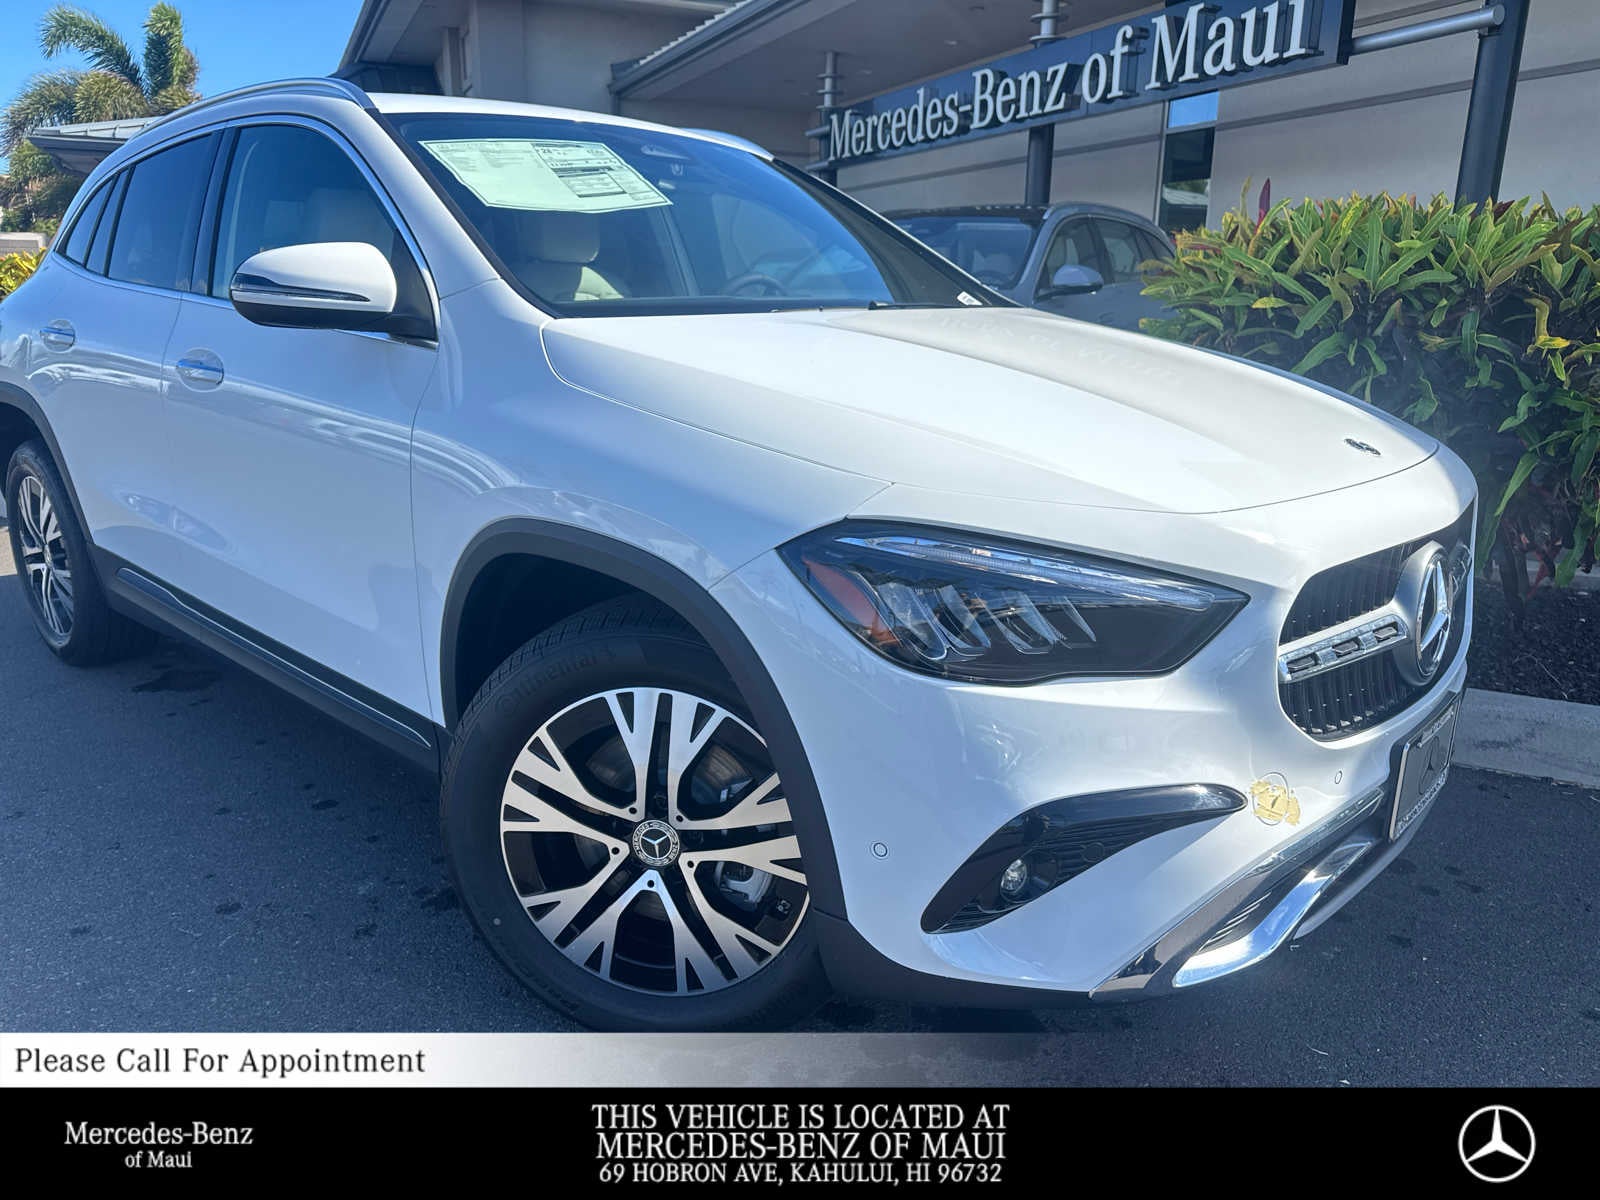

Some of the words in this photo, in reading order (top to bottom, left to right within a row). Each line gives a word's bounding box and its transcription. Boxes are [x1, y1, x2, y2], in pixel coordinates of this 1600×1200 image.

[828, 61, 1068, 162] Mercedes-Benz
[1081, 24, 1134, 104] of
[1145, 0, 1306, 91] Maui
